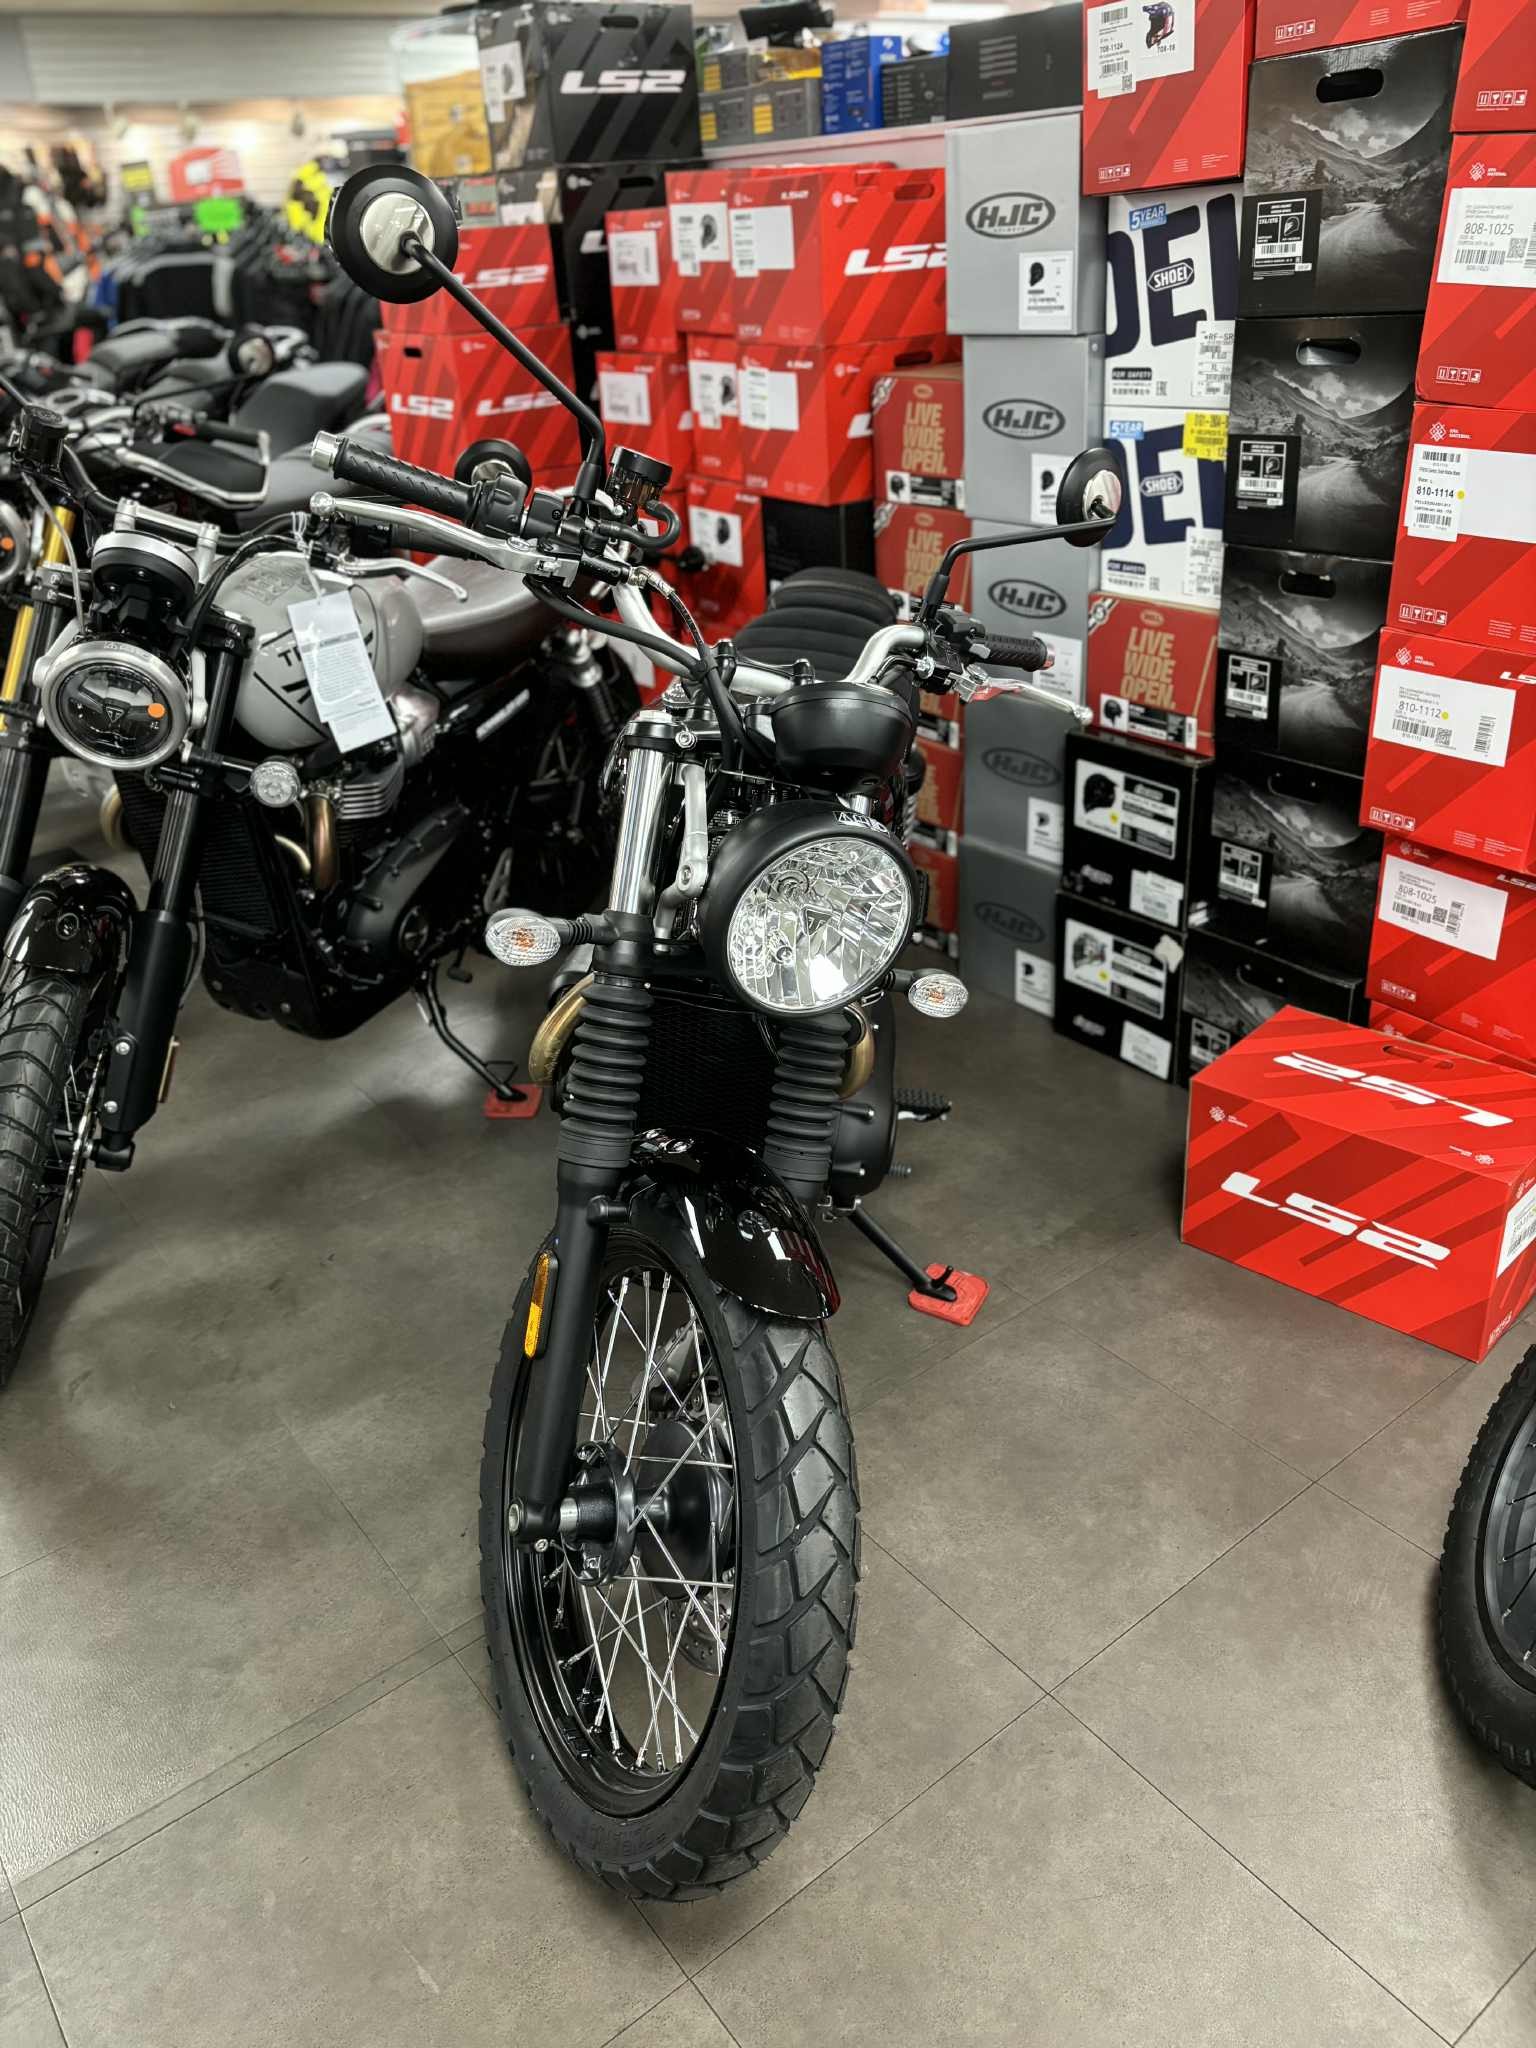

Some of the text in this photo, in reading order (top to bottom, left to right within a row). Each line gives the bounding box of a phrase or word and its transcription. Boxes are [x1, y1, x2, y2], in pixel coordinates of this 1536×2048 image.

[559, 69, 687, 95] LS2
[976, 202, 1044, 228] HJC
[1131, 211, 1141, 229] 5
[1140, 205, 1165, 220] YEAR
[1464, 222, 1515, 236] 808-1025
[453, 264, 549, 289] LS2
[1153, 266, 1188, 289] SHOEI
[391, 393, 454, 420] LS2
[905, 401, 943, 425] LIVE
[992, 408, 1054, 431] HJC
[1111, 422, 1143, 437] 5 YEAR
[902, 424, 945, 450] WIDE
[1144, 477, 1178, 493] SHOEI
[1416, 485, 1454, 499] 810-1114
[907, 528, 944, 553] LIVE
[998, 585, 1056, 613] HJC
[1126, 626, 1176, 657] LIVE
[1123, 651, 1177, 683] WIDE
[1398, 700, 1442, 719] 810-1112
[990, 753, 1054, 782] HJC
[1397, 884, 1438, 905] 808-1025
[1272, 1051, 1513, 1127] LS2
[1220, 1171, 1451, 1271] LS2
